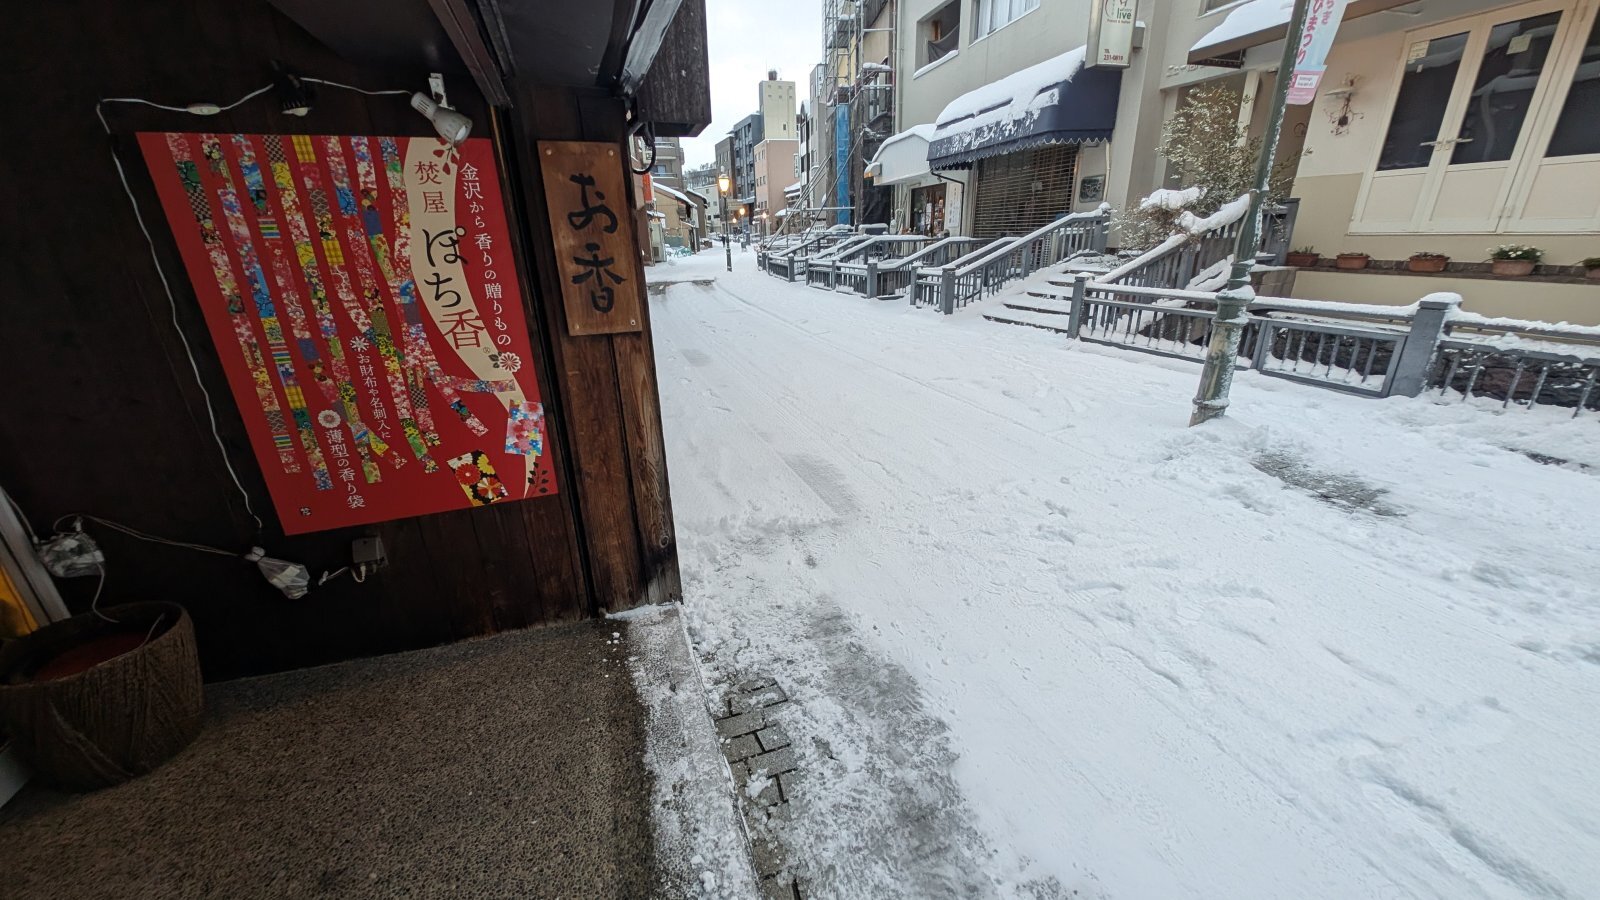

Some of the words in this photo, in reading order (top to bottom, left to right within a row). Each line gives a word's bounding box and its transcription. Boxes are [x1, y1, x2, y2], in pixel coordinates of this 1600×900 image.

[1117, 8, 1132, 19] live
[414, 161, 448, 214] 焚屋
[422, 226, 486, 349] ぽち香
[460, 162, 511, 346] 金沢から香りの贈りもの
[567, 173, 627, 313] お香
[325, 429, 366, 509] 薄型の香り袋
